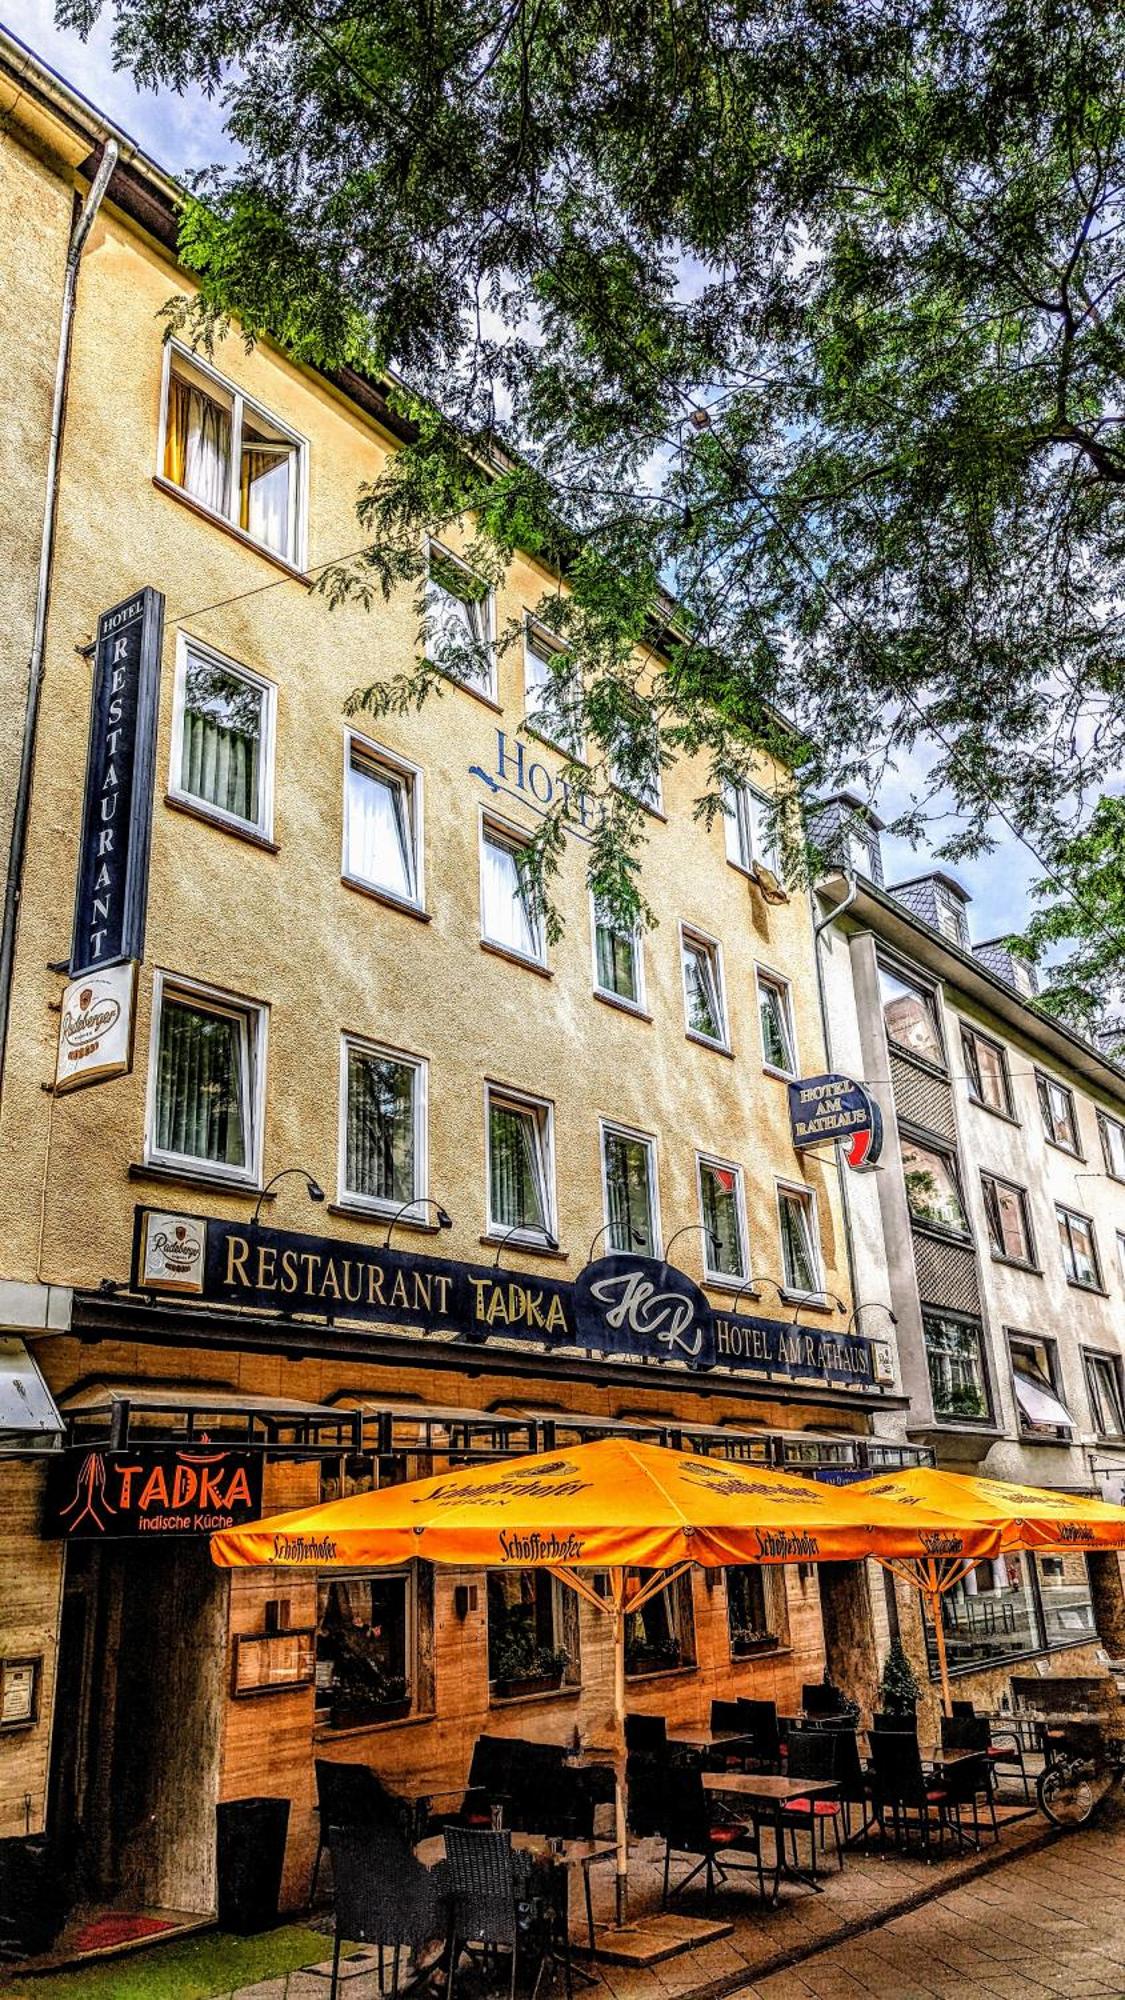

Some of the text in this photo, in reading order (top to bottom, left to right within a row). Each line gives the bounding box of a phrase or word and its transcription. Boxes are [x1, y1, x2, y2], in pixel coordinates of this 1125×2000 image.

[103, 601, 144, 634] HOTEL
[91, 636, 129, 960] RESTAURANT
[800, 1080, 854, 1103] HOTEL
[816, 1098, 842, 1116] AM
[795, 1108, 866, 1136] RATHAUS
[223, 1234, 568, 1333] RESTAURANT TADKA
[716, 1319, 773, 1360] HOTEL
[805, 1335, 867, 1374] RATHAUS
[114, 1463, 252, 1511] TADKA
[139, 1514, 233, 1531] indische Küche
[268, 1535, 337, 1563] Schöfferhofer
[499, 1529, 585, 1563] Schöfferhofer
